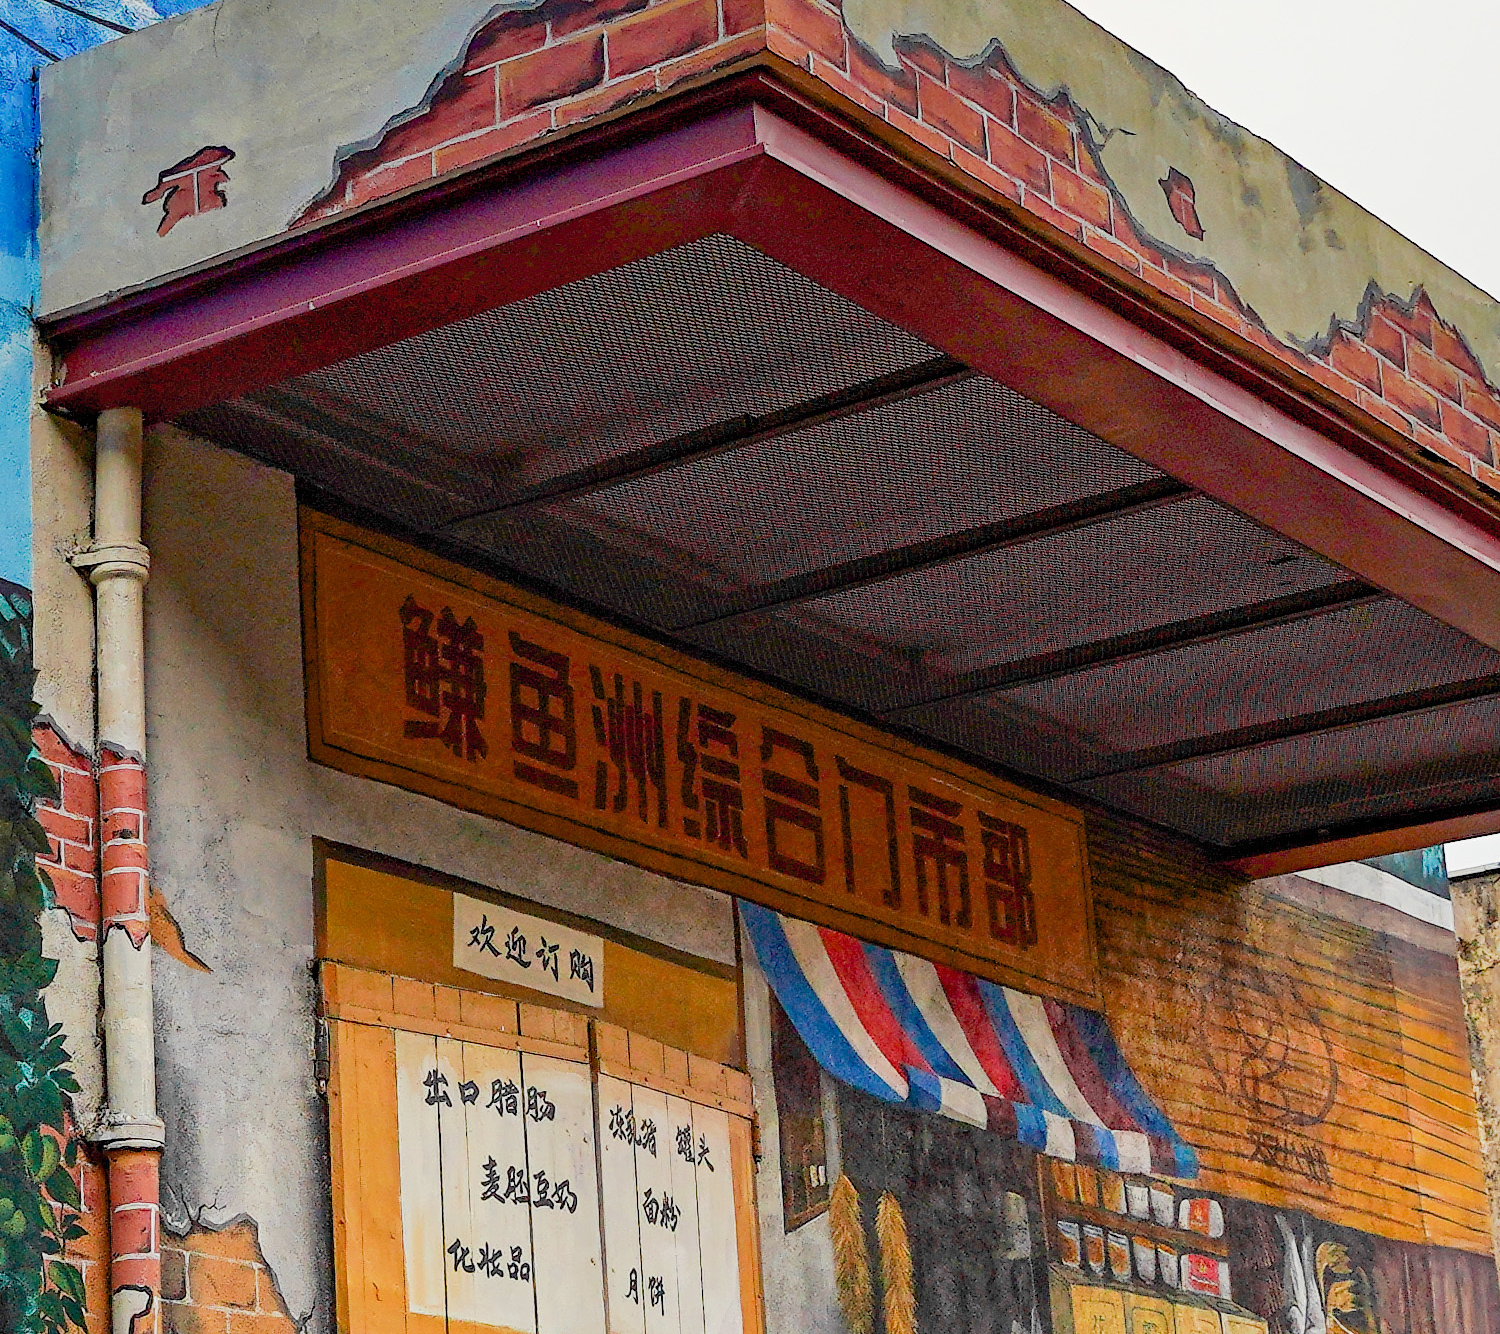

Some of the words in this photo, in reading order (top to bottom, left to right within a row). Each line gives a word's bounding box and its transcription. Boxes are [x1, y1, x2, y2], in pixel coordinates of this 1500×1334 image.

[467, 914, 594, 993] 欢迎订购
[423, 1069, 556, 1122] 出口腊肠
[676, 1123, 715, 1172] 罐头
[480, 1155, 578, 1214] 麦胚豆奶
[642, 1187, 681, 1232] 面粉
[447, 1238, 531, 1282] 化妆品
[625, 1267, 665, 1316] 月饼
